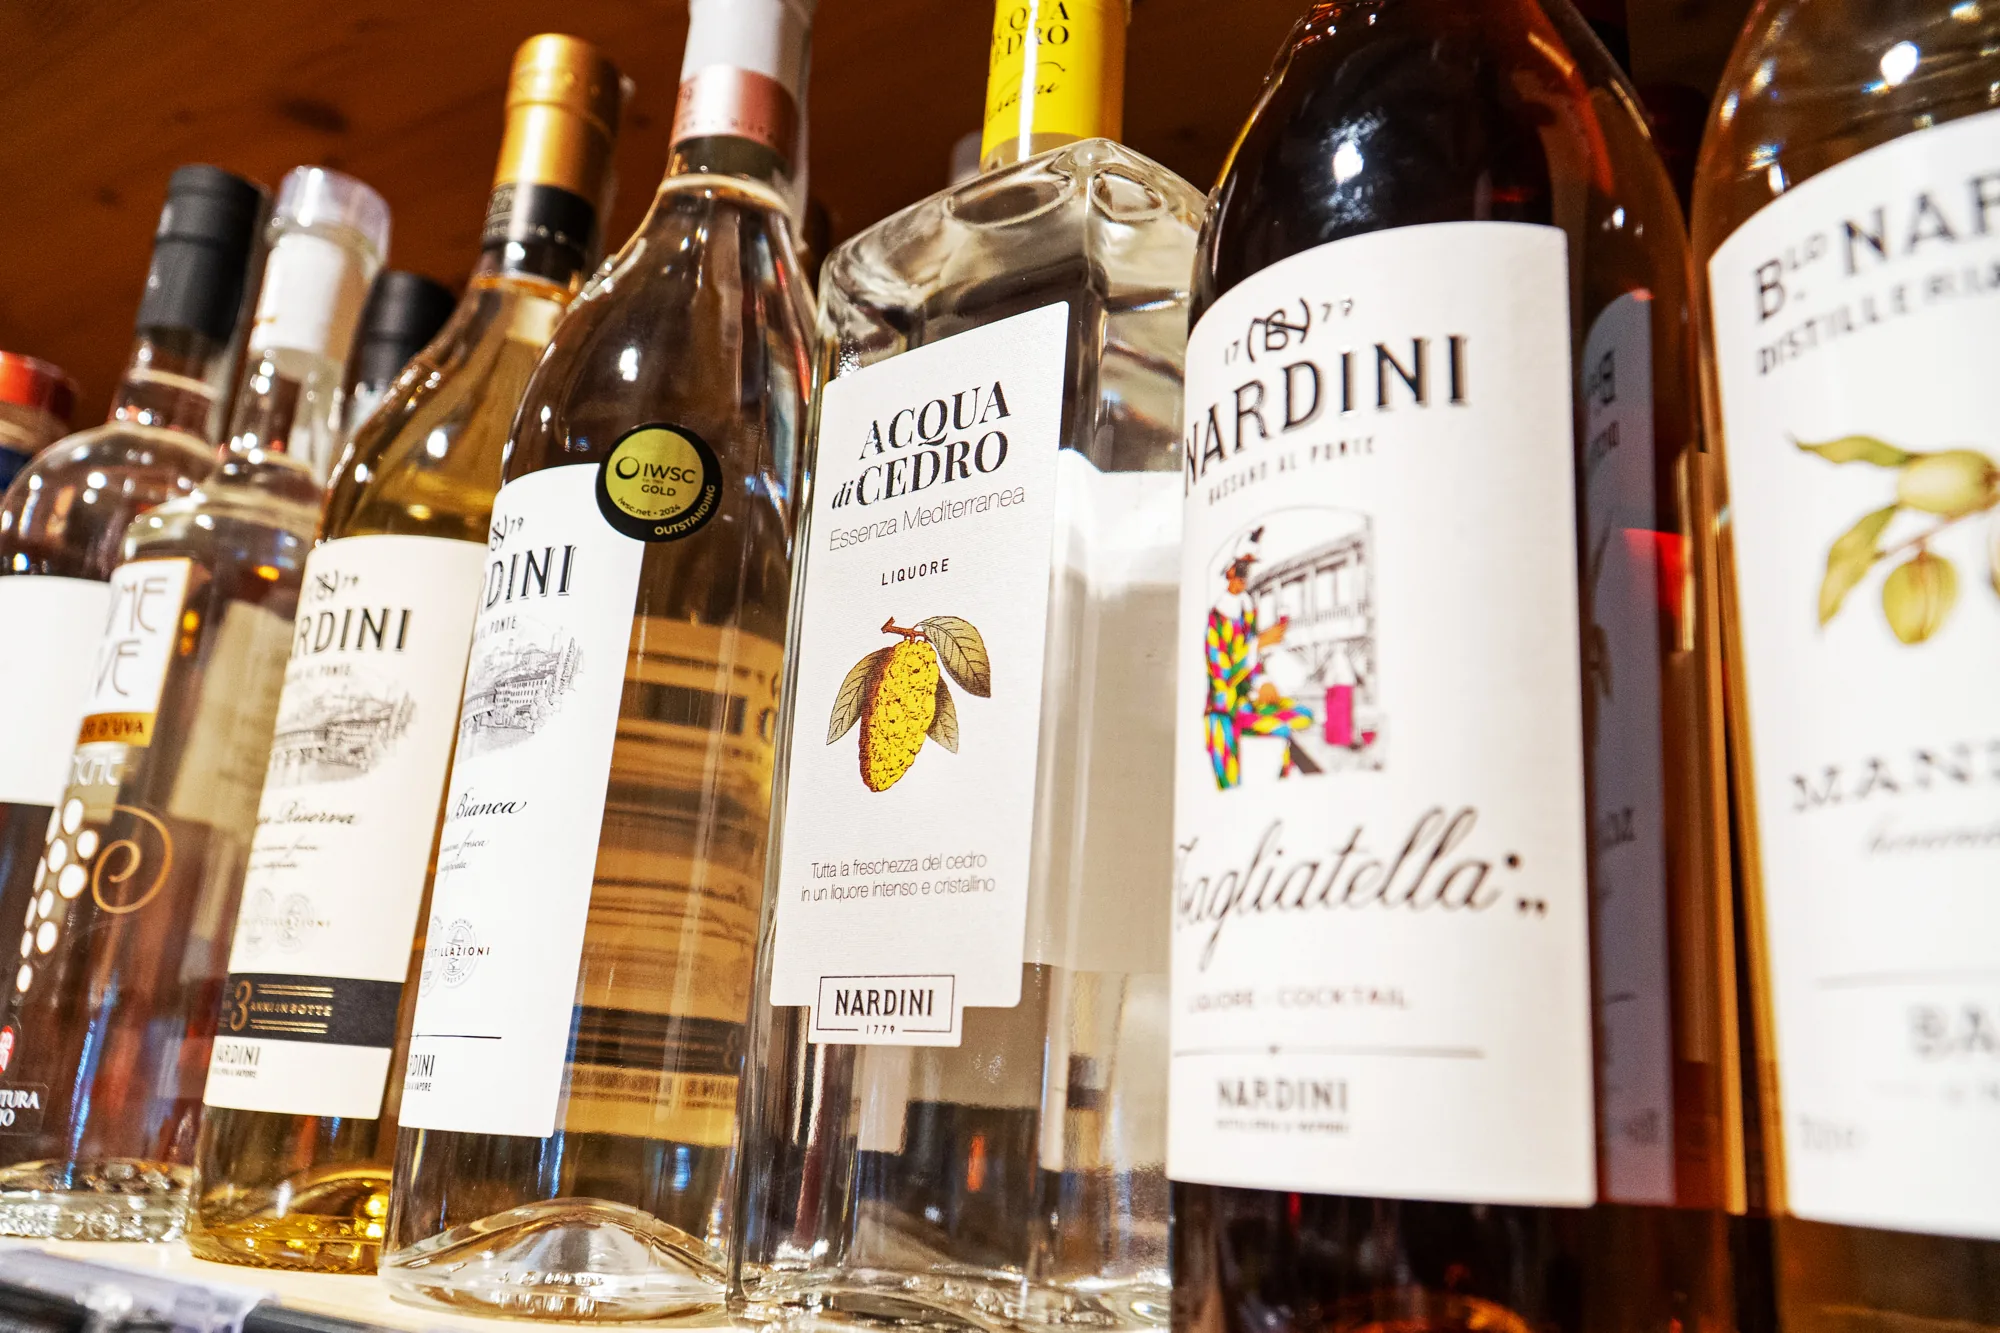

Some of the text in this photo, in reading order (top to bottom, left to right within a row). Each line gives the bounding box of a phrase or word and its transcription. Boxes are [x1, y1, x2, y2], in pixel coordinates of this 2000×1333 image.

[859, 381, 1011, 460] ACQUA
[1185, 333, 1471, 498] NARDINI
[643, 463, 696, 484] IWSC
[832, 430, 1009, 509] di CEDRO
[641, 484, 676, 496] GOLD
[617, 496, 681, 517] iwsc.net 2024
[654, 484, 716, 536] OUTSTANDING
[829, 486, 1025, 552] Essenza Mediterranea
[881, 558, 950, 586] LIQUORE
[811, 851, 987, 879] Tutta la freschezza del cedro
[801, 877, 996, 903] in un liquore intenso e cristallino
[230, 980, 252, 1032] 3
[834, 989, 935, 1017] NARDINI
[866, 1025, 895, 1035] 1779
